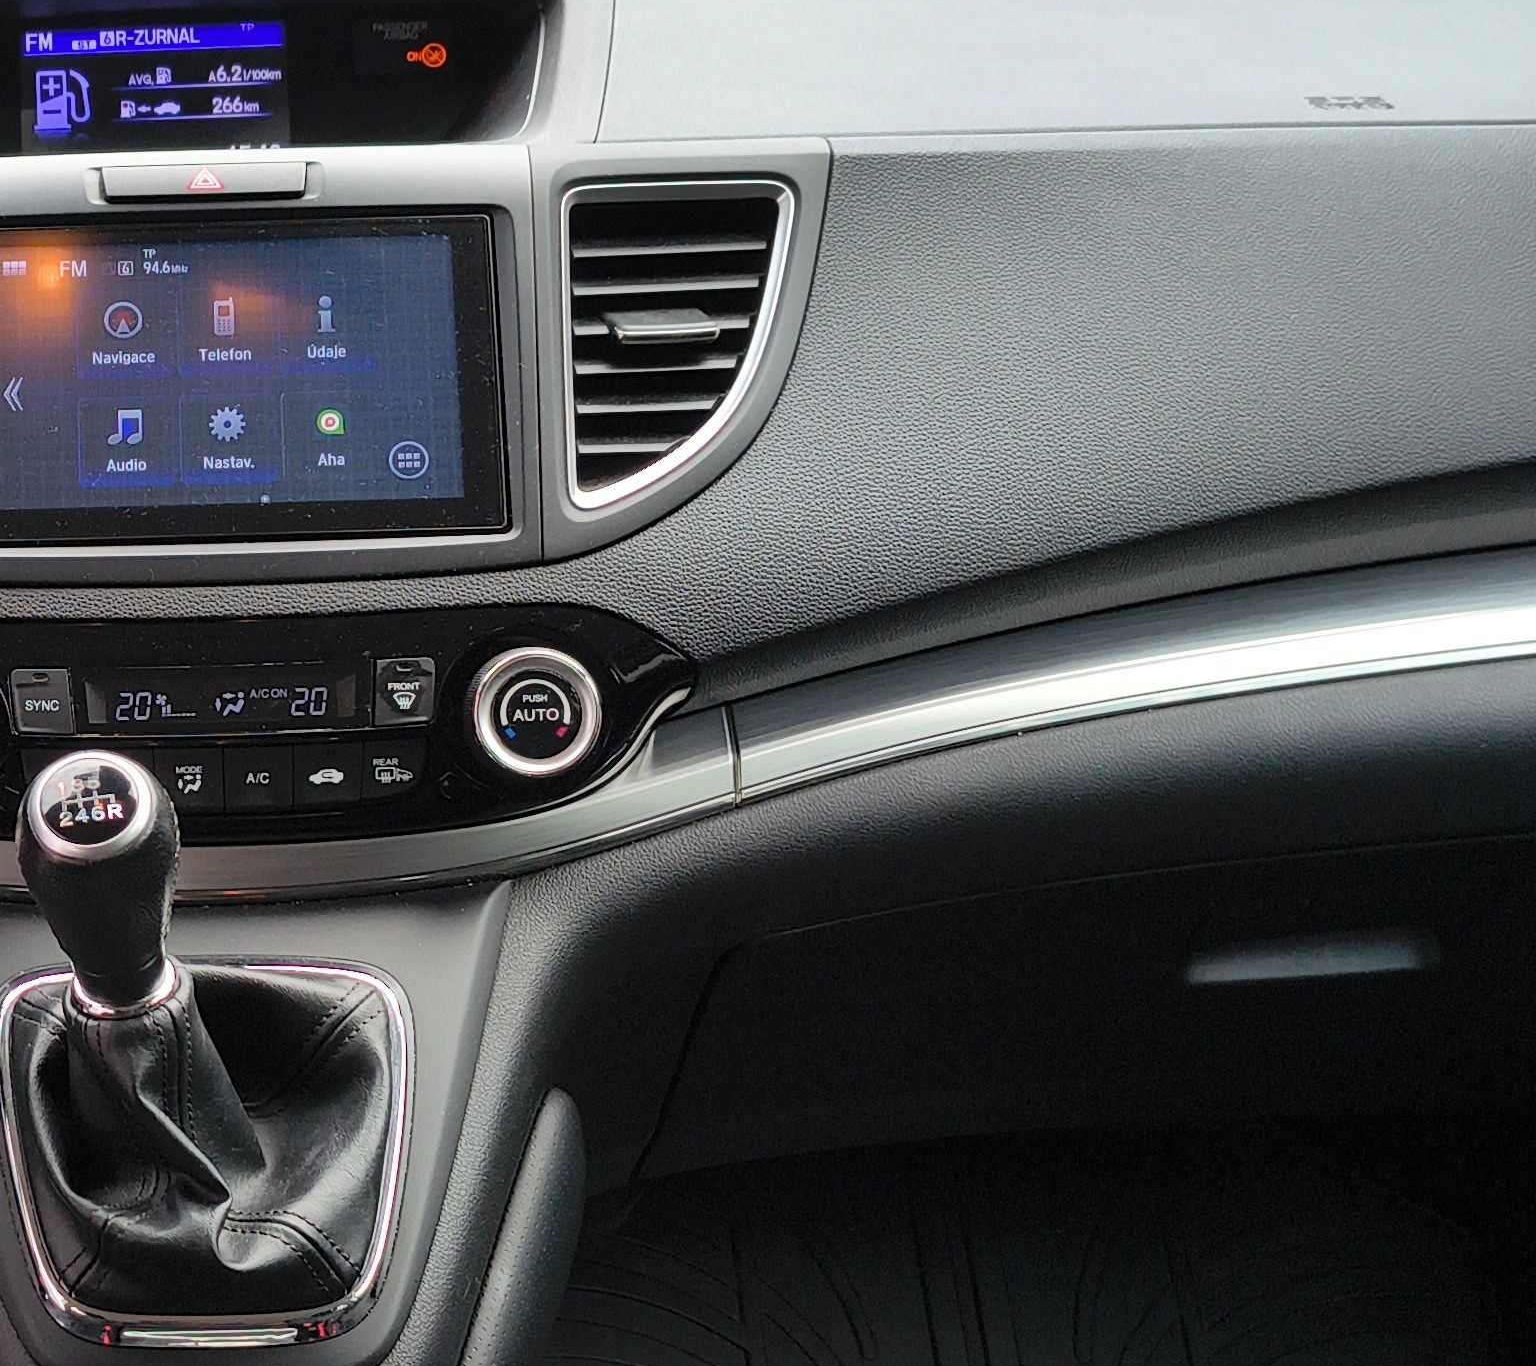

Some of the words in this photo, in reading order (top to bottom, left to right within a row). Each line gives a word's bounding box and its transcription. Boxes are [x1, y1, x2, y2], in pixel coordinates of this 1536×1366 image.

[25, 32, 53, 52] FM
[116, 27, 200, 47] R-ZURNAL
[406, 50, 422, 62] ON
[128, 74, 154, 86] AVG.
[59, 260, 87, 278] FM
[92, 351, 156, 366] Navigace
[198, 347, 252, 362] Telefon
[307, 344, 348, 360] Údaje
[106, 458, 147, 473] Audio
[203, 455, 256, 470] Nastav.
[317, 453, 346, 467] Aha
[387, 682, 420, 691] FRONT
[290, 687, 328, 716] 20
[522, 694, 548, 703] PUSH
[24, 699, 60, 712] SYNC
[115, 691, 152, 721] 20
[512, 707, 560, 722] AUTO
[373, 758, 399, 767] REAR
[175, 765, 203, 774] MODE
[246, 772, 270, 784] A/C
